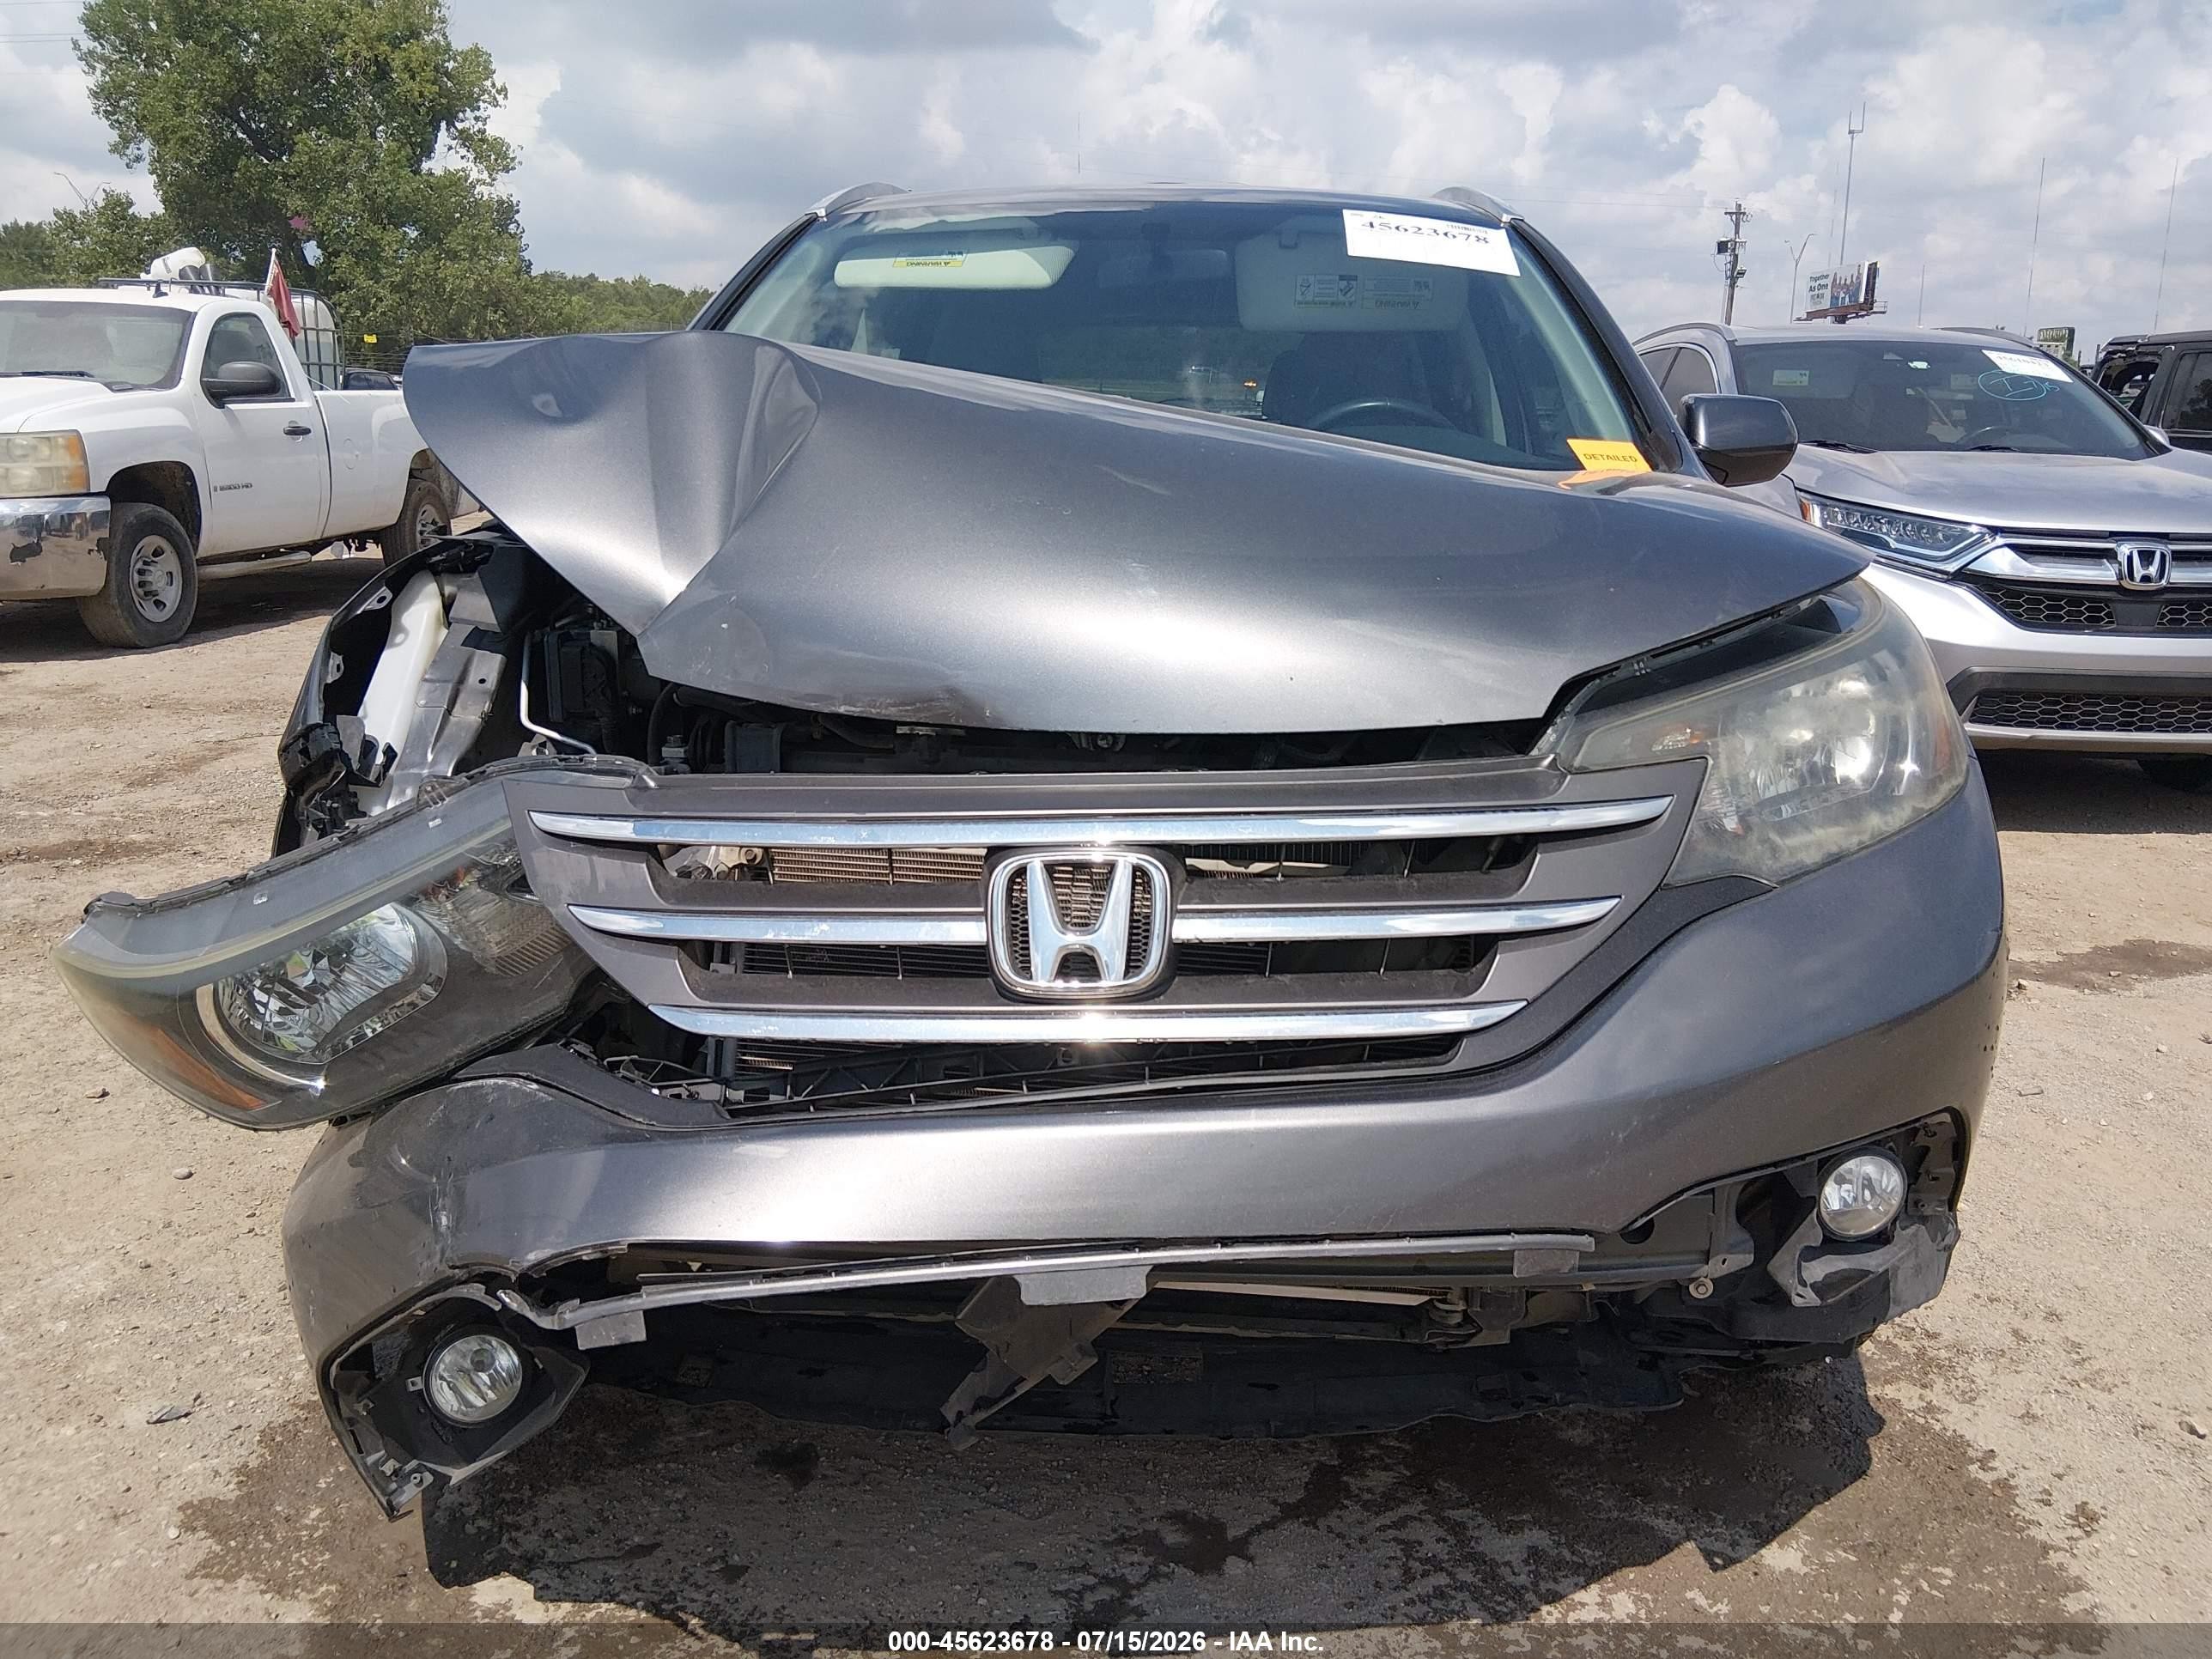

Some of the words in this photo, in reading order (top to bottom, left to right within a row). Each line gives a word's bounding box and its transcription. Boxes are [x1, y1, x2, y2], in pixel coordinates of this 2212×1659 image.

[1362, 221, 1491, 243] 45623678
[1817, 283, 1829, 291] One
[1583, 453, 1638, 463] DETAILED
